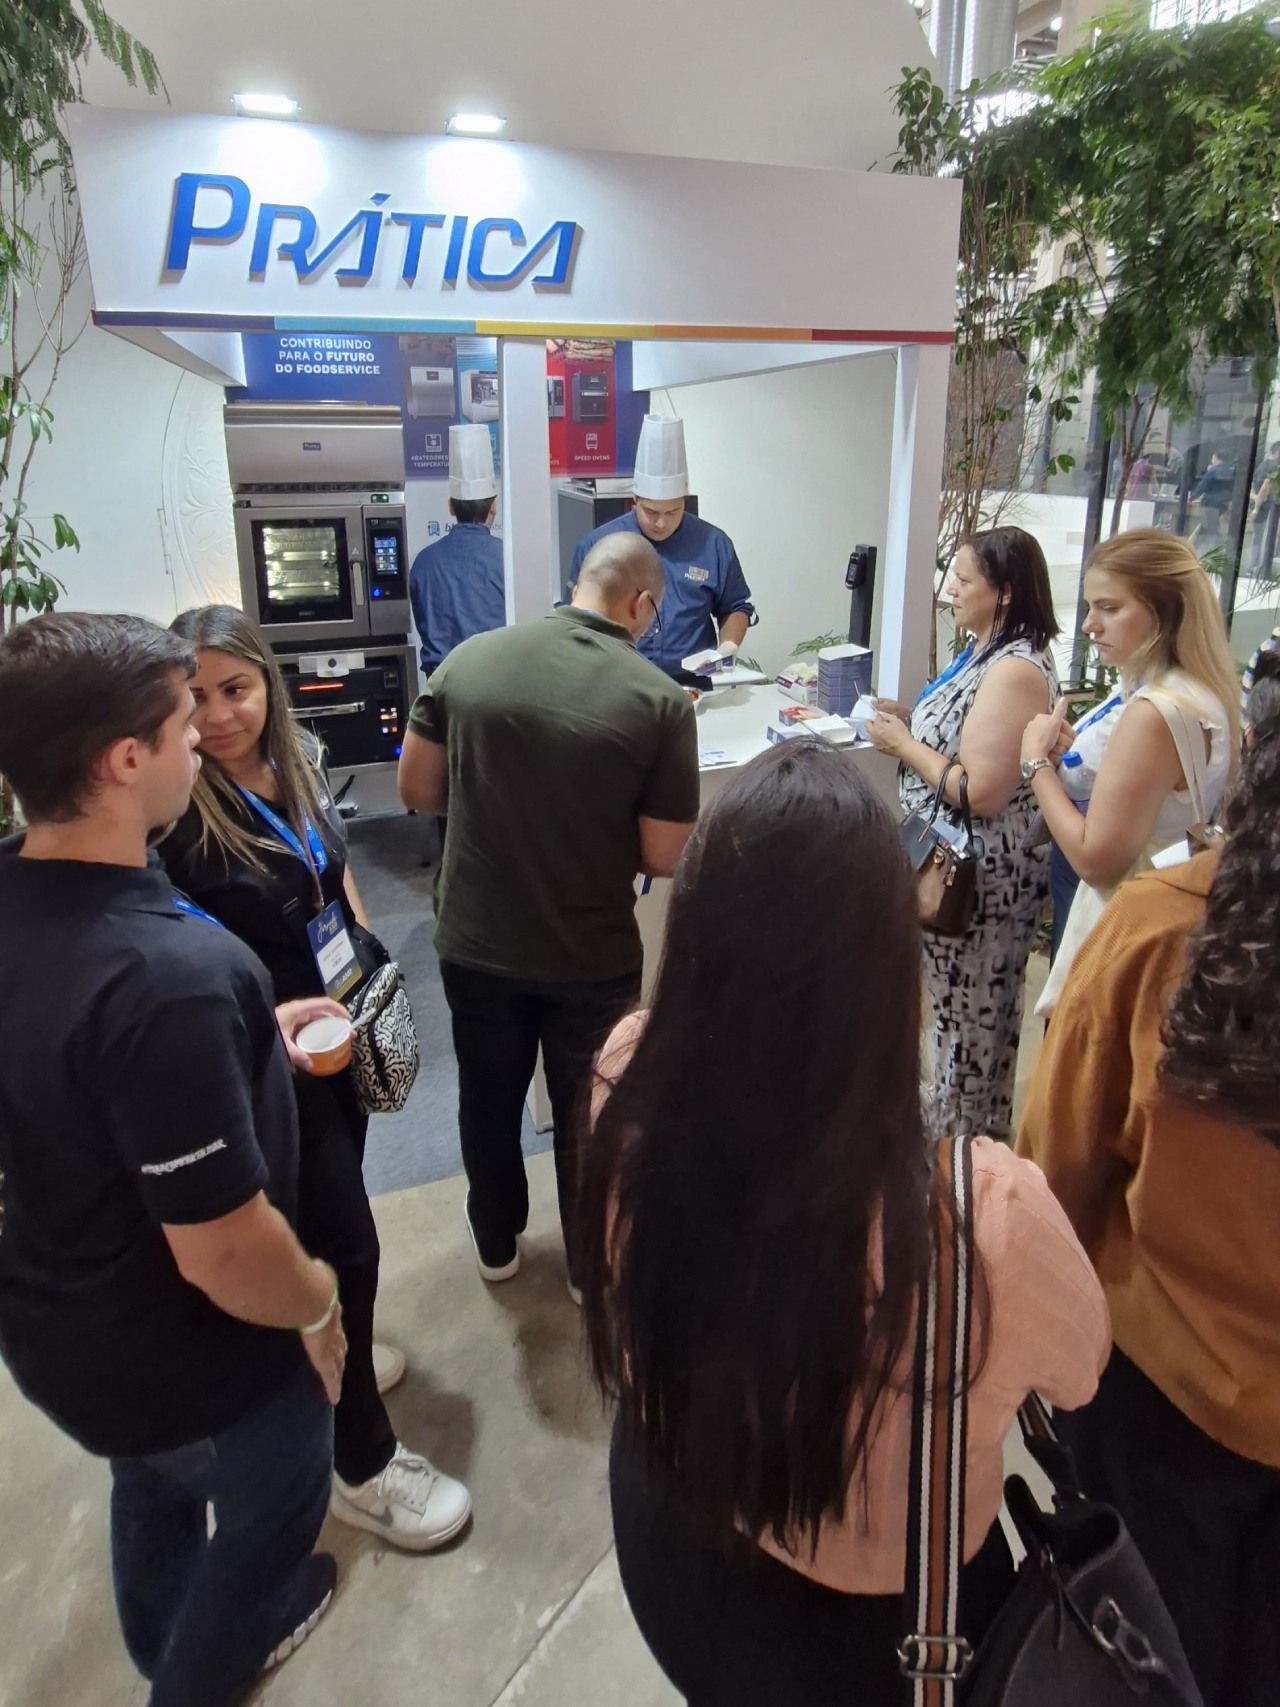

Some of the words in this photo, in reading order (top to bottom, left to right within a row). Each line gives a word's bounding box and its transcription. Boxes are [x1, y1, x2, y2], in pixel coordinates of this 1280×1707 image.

[166, 172, 580, 286] PRÁTICA
[280, 337, 372, 350] CONTRIBUINDO
[279, 350, 310, 361] PARA
[313, 351, 323, 362] O
[326, 351, 375, 362] FUTURO
[275, 363, 293, 374] DO
[296, 363, 381, 375] FOODSERVICE
